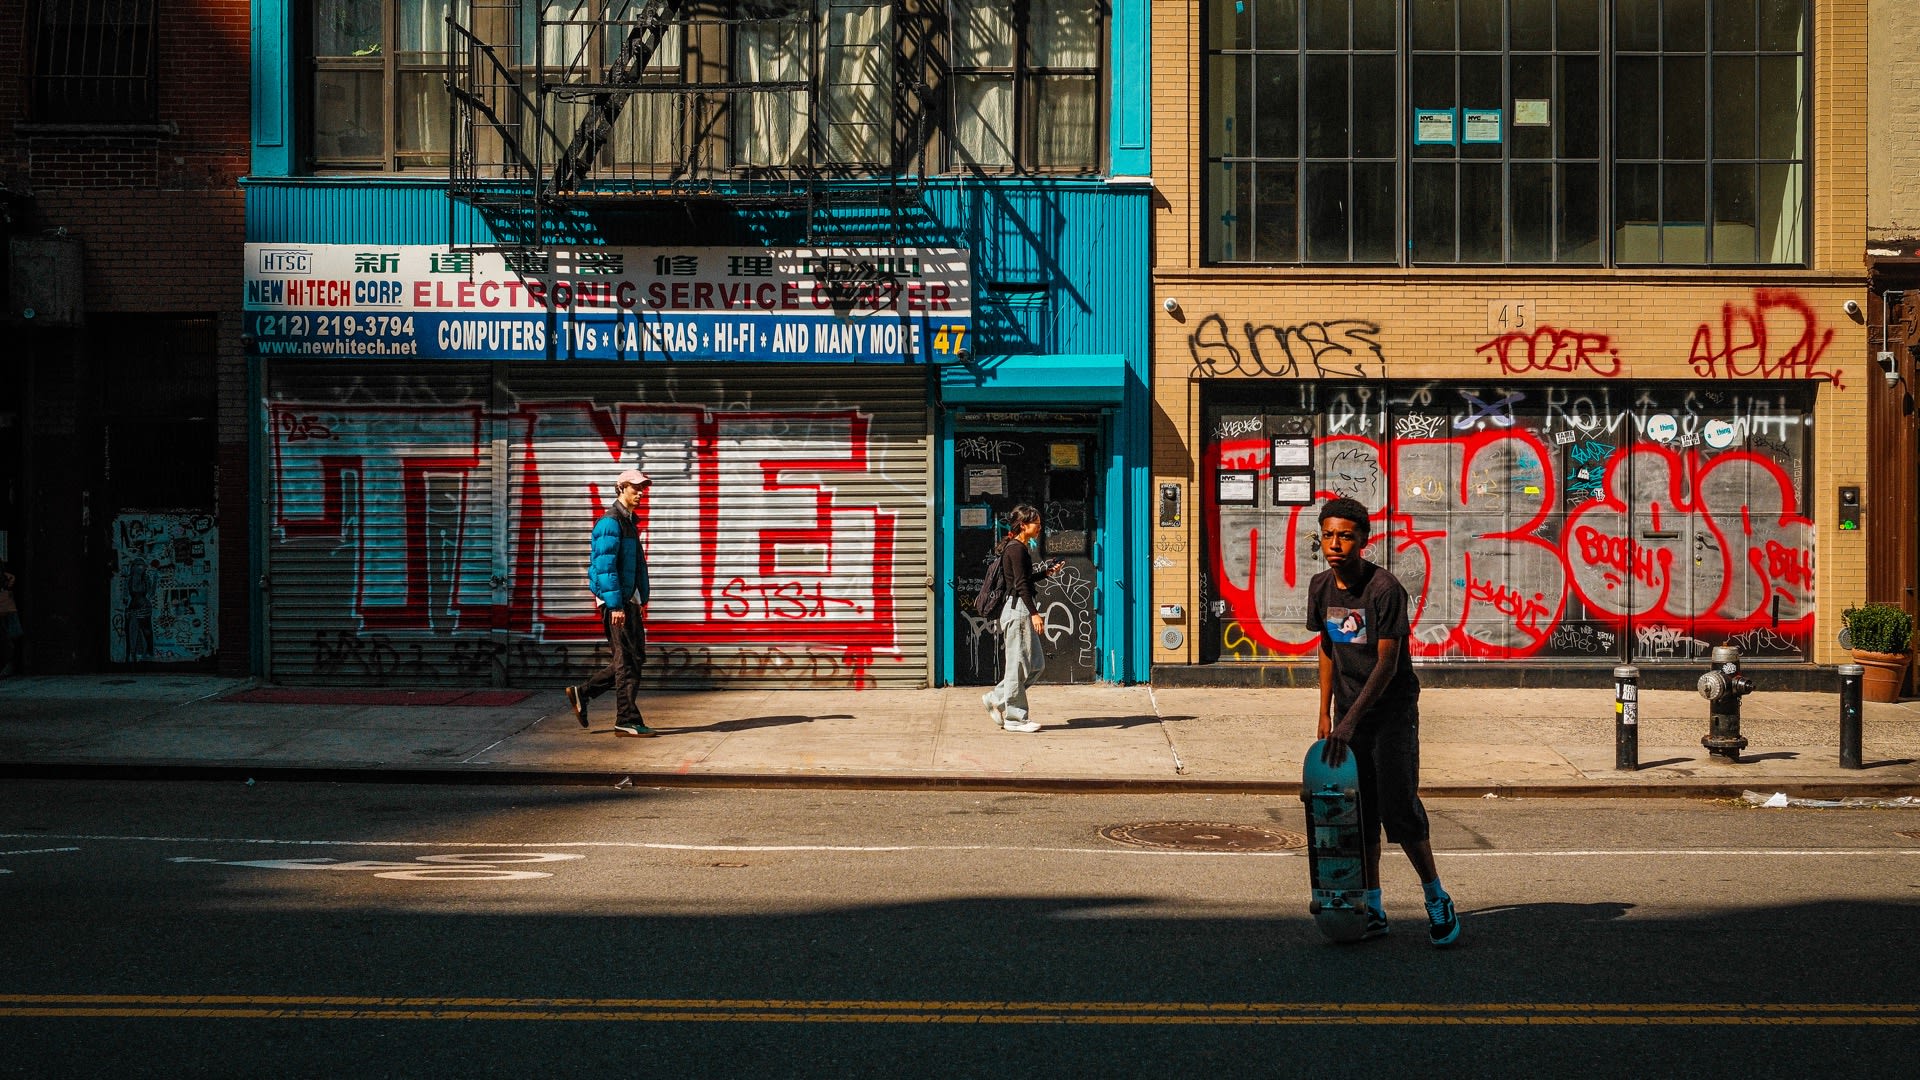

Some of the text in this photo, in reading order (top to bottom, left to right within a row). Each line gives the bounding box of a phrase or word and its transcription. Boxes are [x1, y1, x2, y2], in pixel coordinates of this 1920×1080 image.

[265, 253, 307, 270] HTSC
[248, 280, 403, 306] NEW HI-TECH CORP.
[413, 281, 637, 309] ELECTRONIC
[648, 281, 799, 310] SERVICE
[256, 316, 415, 337] (212) 219-3794
[437, 320, 920, 354] COMPUTERS TVs CAMERAS HI-FI AND MANY MORE
[258, 339, 417, 356] www.newhitech.net
[933, 324, 967, 355] 47
[1659, 423, 1675, 432] thing
[1716, 427, 1732, 436] thing
